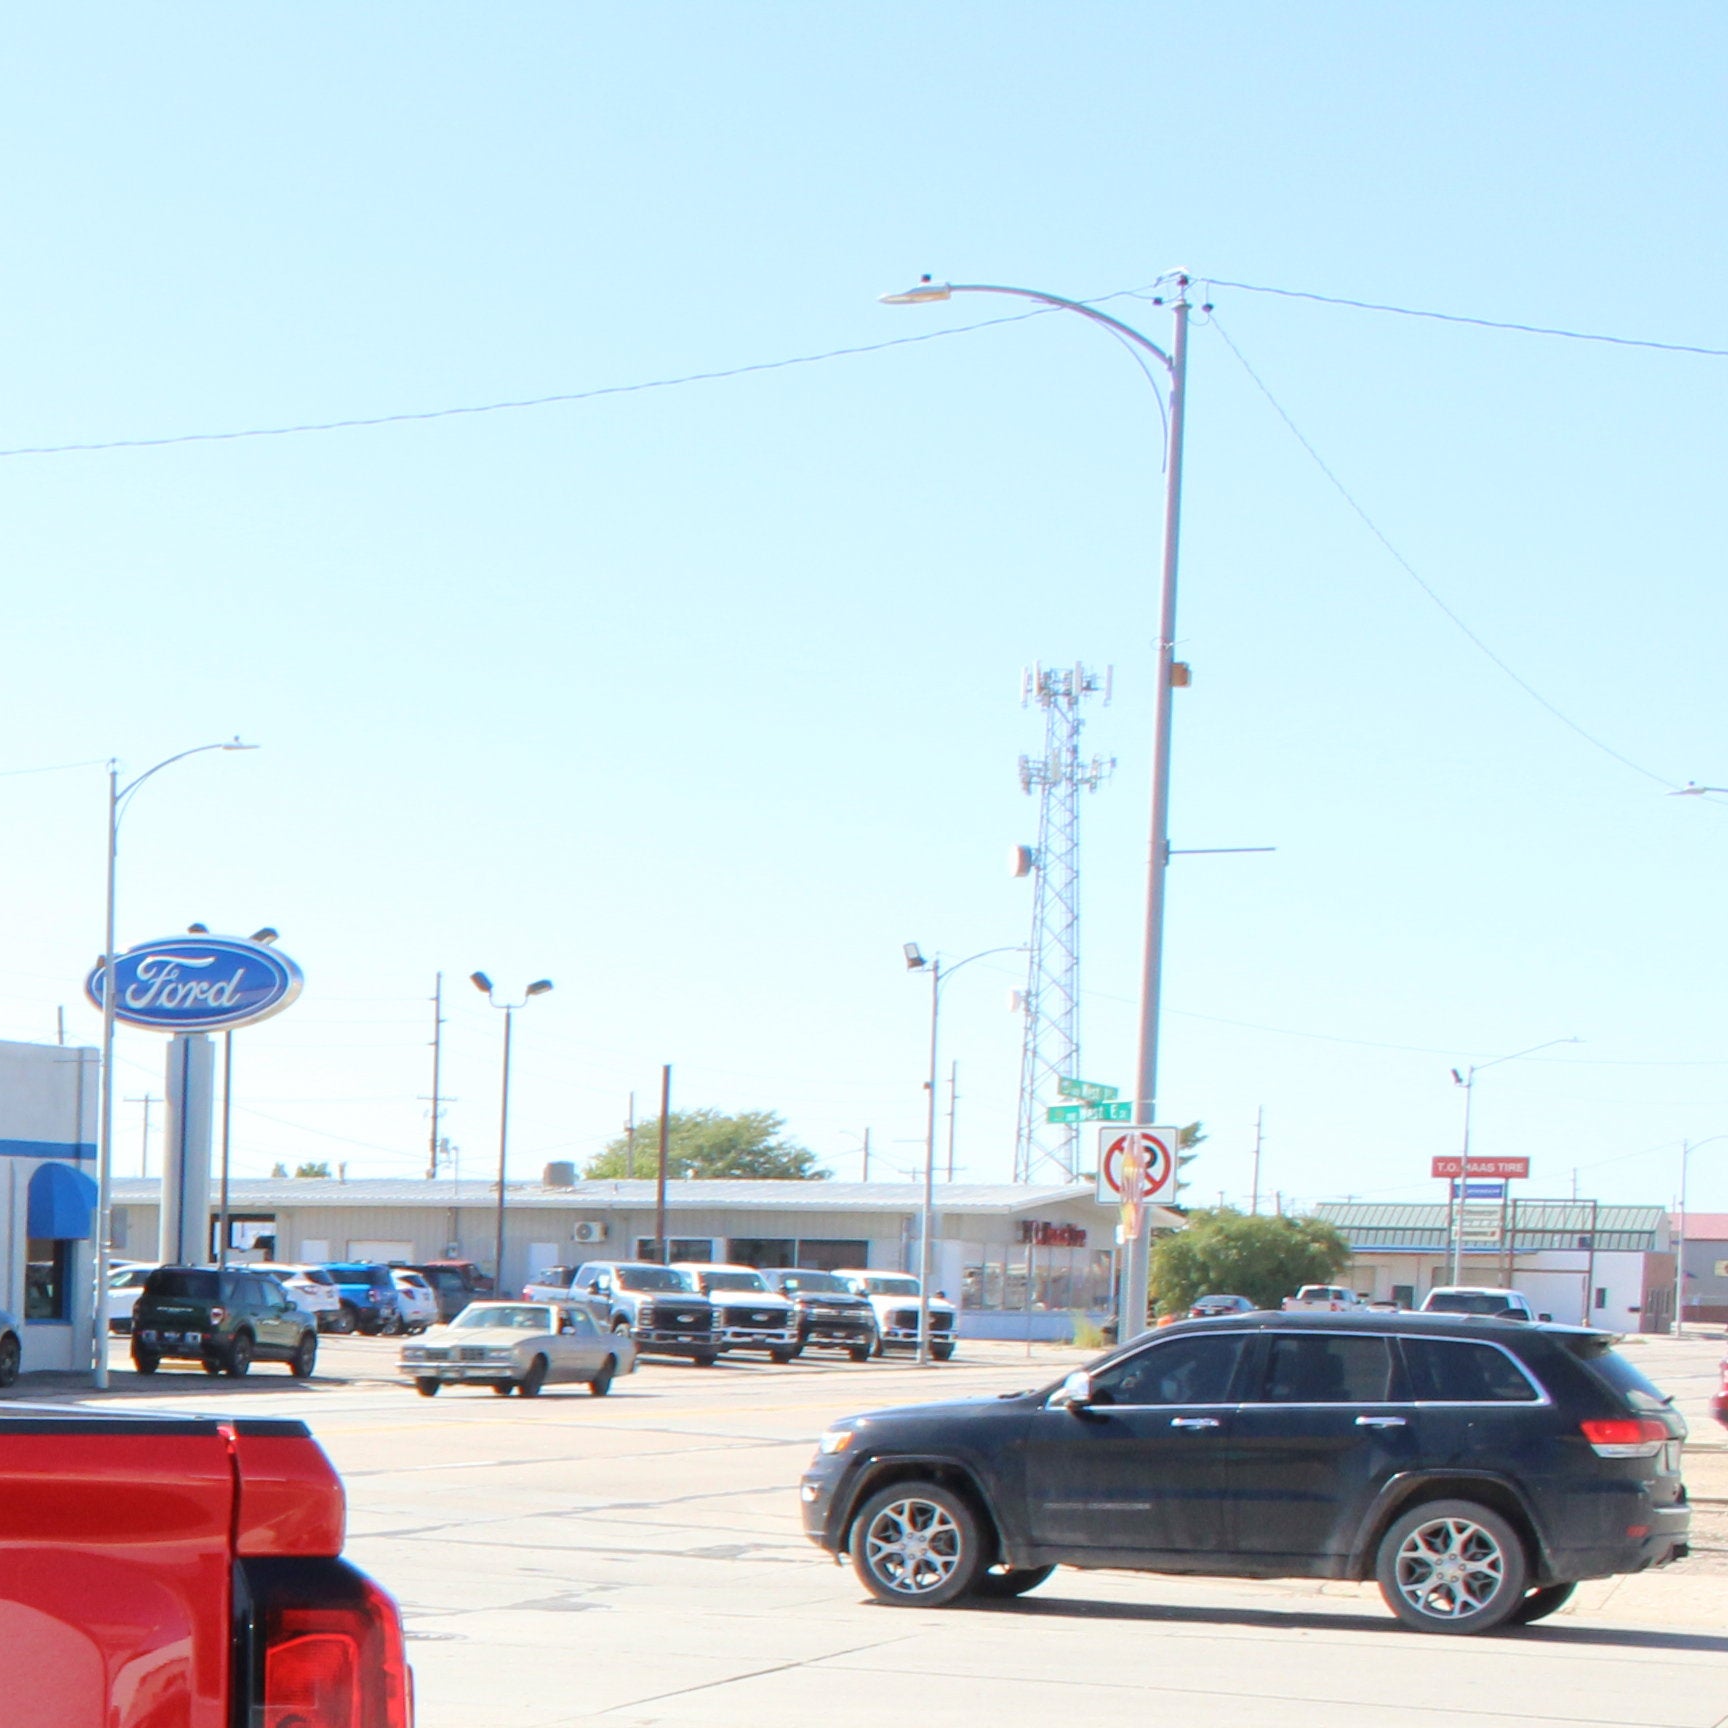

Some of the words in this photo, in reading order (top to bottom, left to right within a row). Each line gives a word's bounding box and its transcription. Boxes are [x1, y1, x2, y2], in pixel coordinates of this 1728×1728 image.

[125, 955, 245, 1009] Ford
[1437, 1162, 1458, 1173] T.O.
[1497, 1162, 1524, 1173] TIRE
